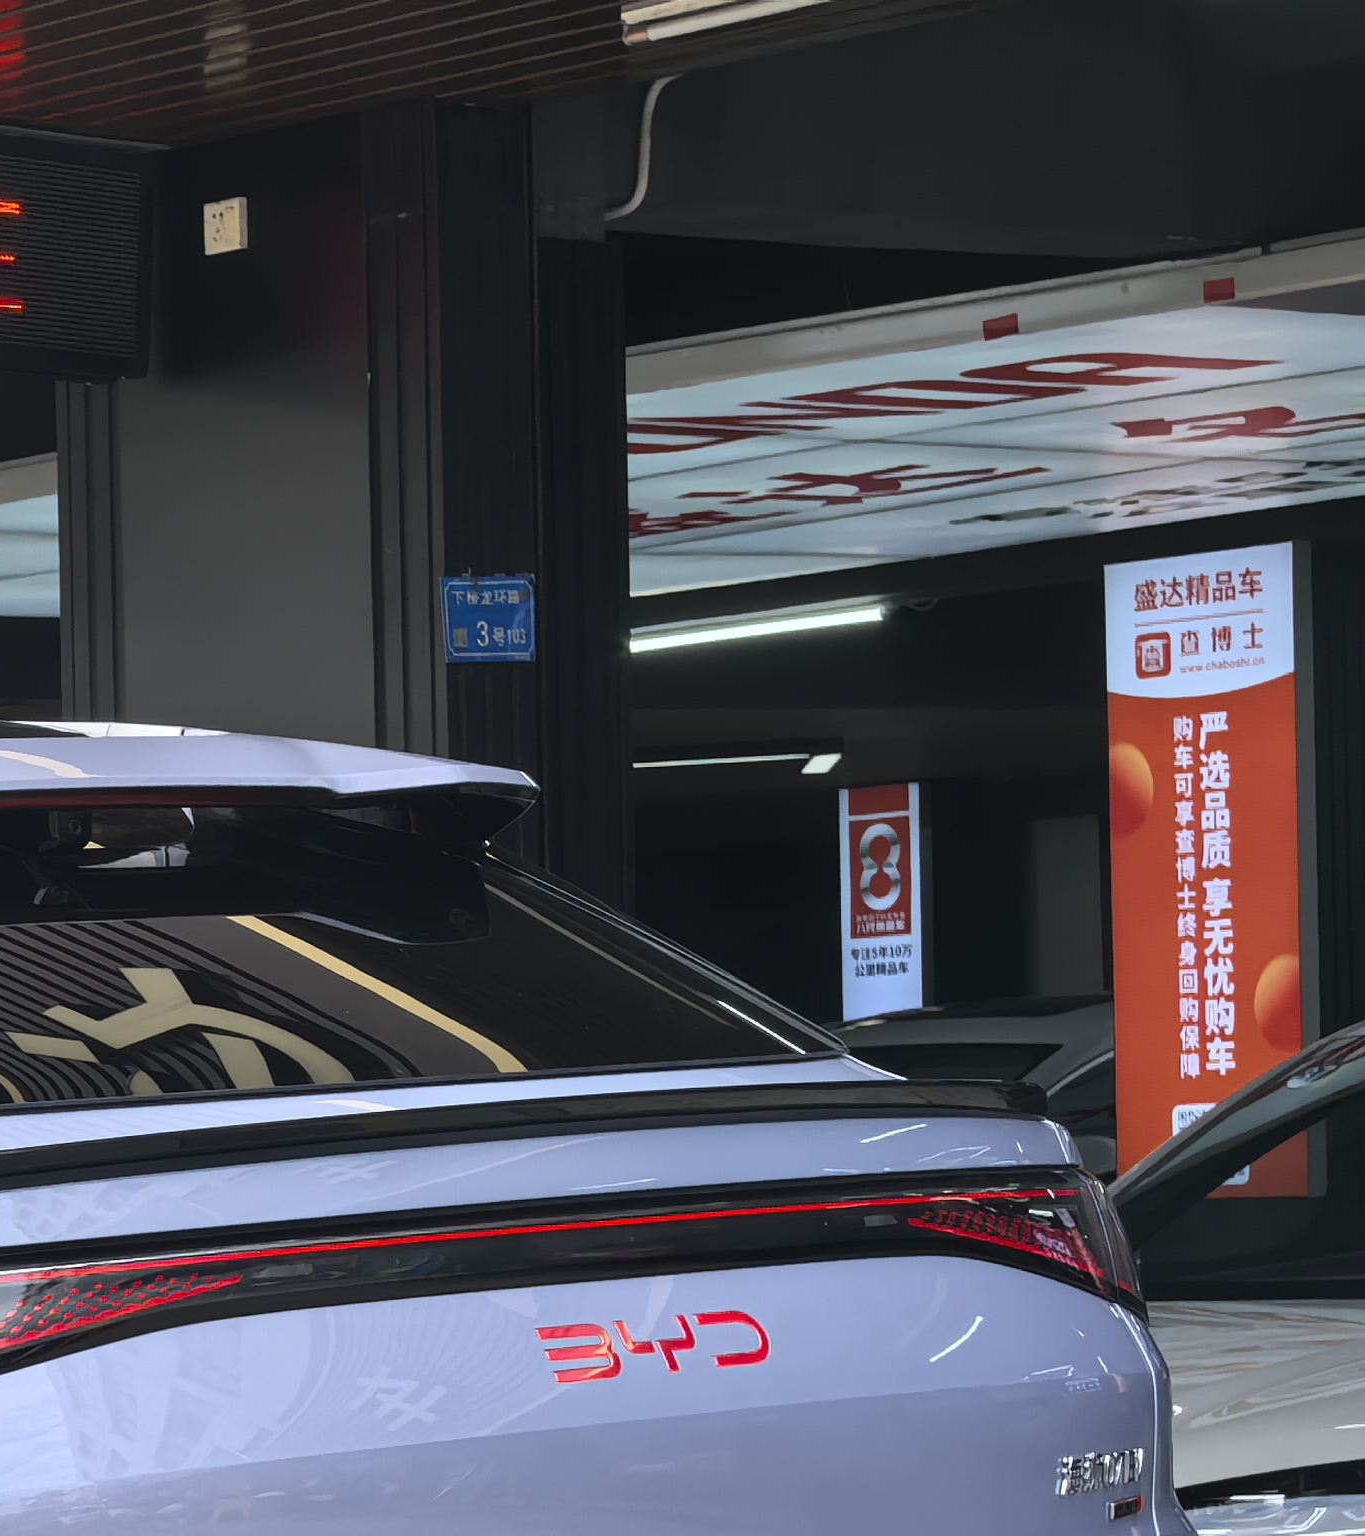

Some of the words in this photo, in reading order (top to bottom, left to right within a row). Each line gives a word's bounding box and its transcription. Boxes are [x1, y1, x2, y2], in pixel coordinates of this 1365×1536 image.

[1134, 567, 1264, 612] 盛达精品车
[1199, 711, 1232, 868] 严选品质
[1202, 878, 1237, 1076] 享无忧购车
[535, 1310, 771, 1384] BYD
